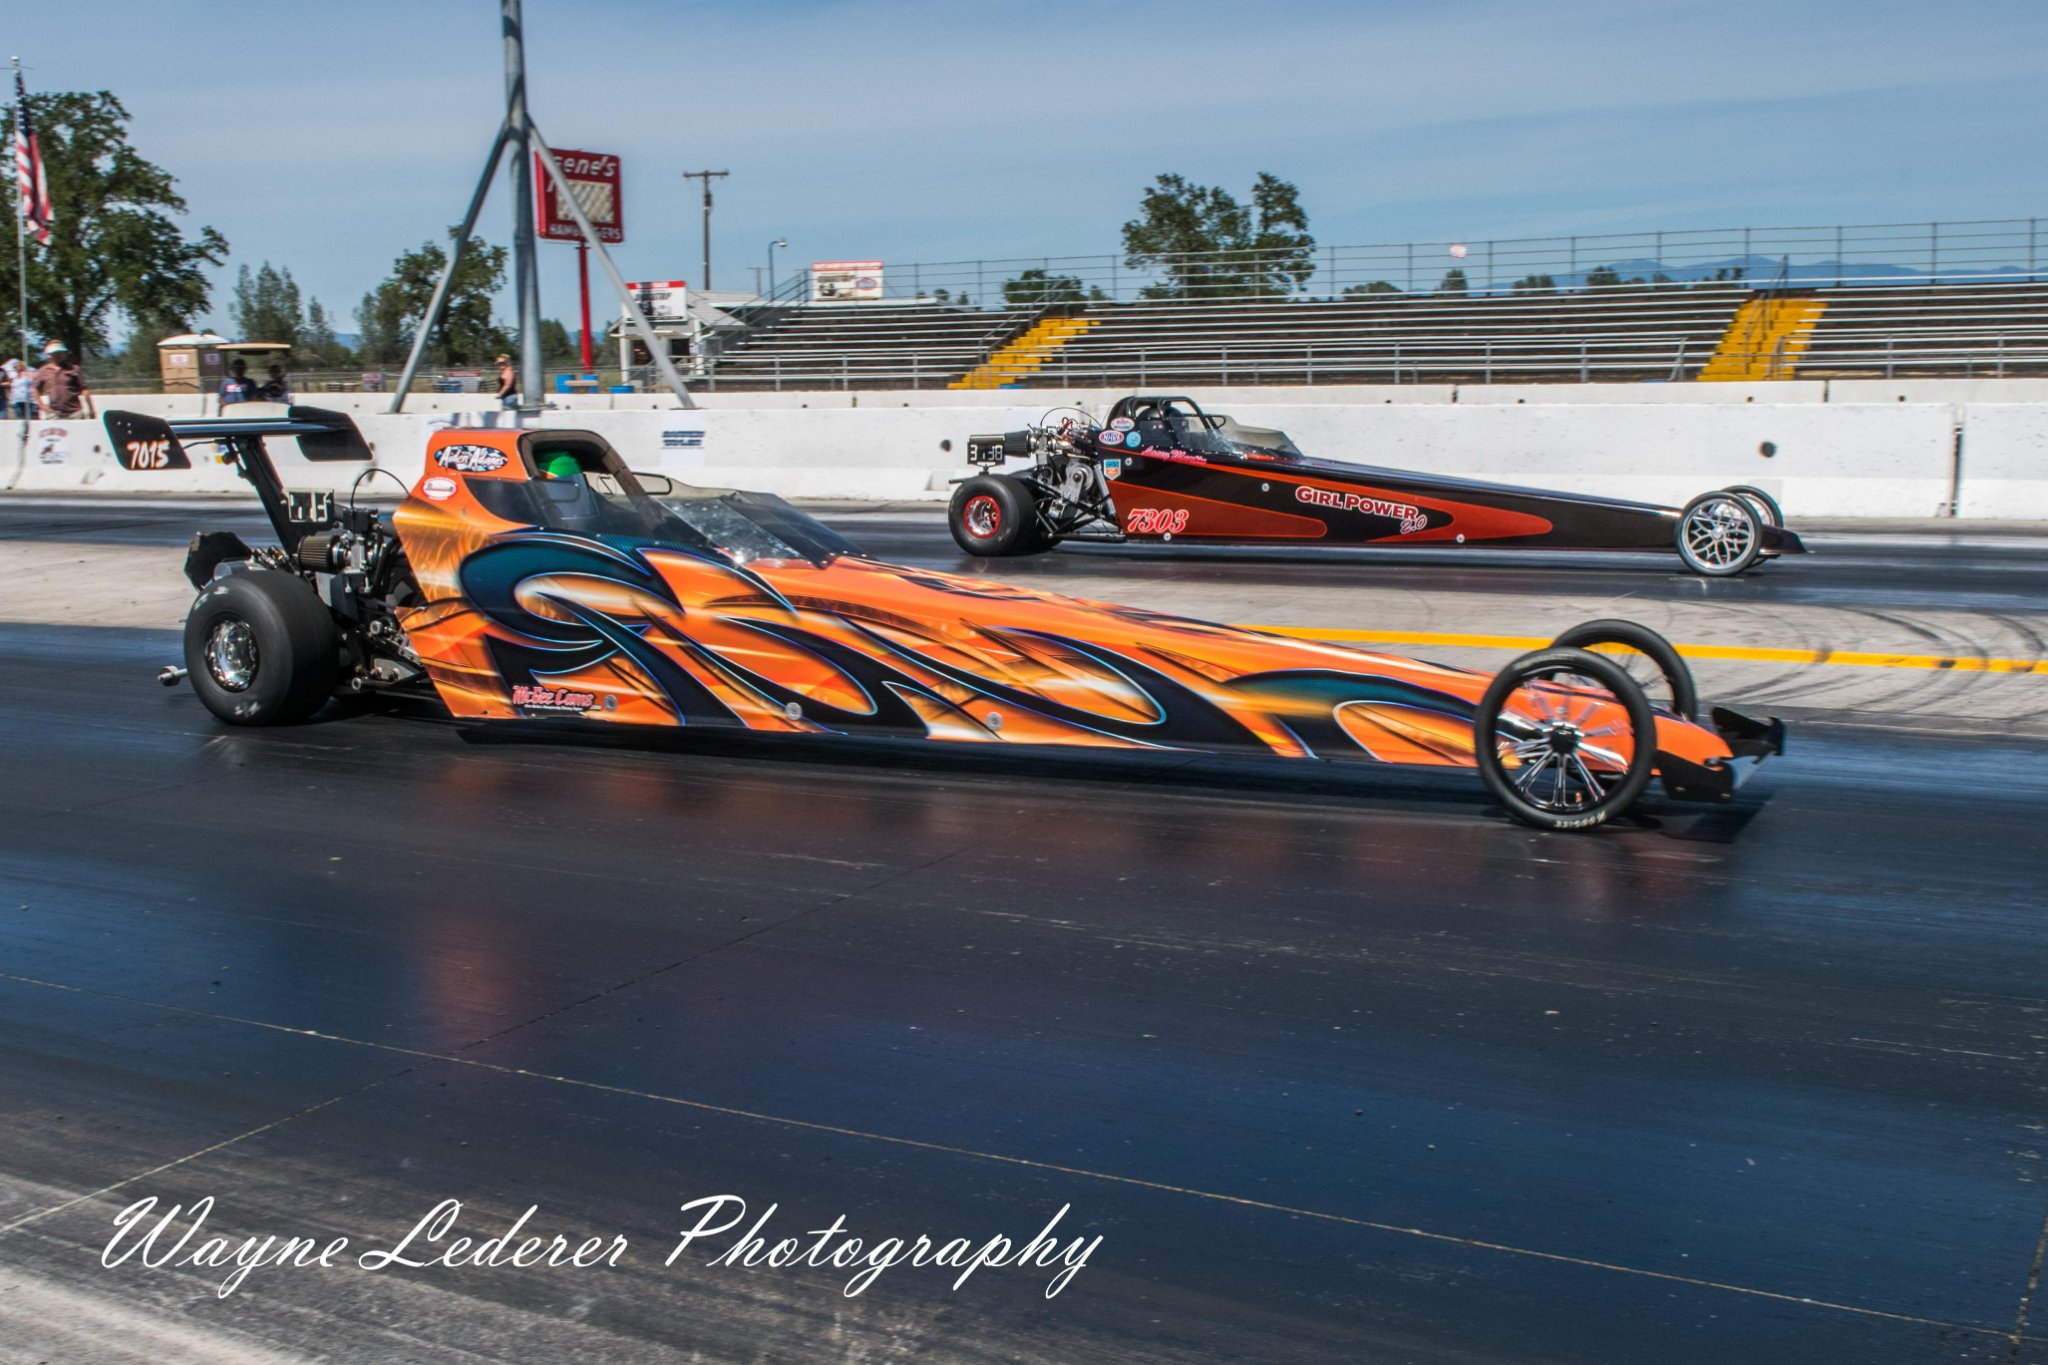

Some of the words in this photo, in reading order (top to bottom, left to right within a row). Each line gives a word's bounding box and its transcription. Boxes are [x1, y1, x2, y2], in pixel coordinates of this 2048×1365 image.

[126, 439, 171, 470] 7015
[1295, 485, 1344, 510] GIRL
[1344, 493, 1419, 521] POWER
[1127, 508, 1190, 534] 7303
[1400, 514, 1428, 534] 2.0
